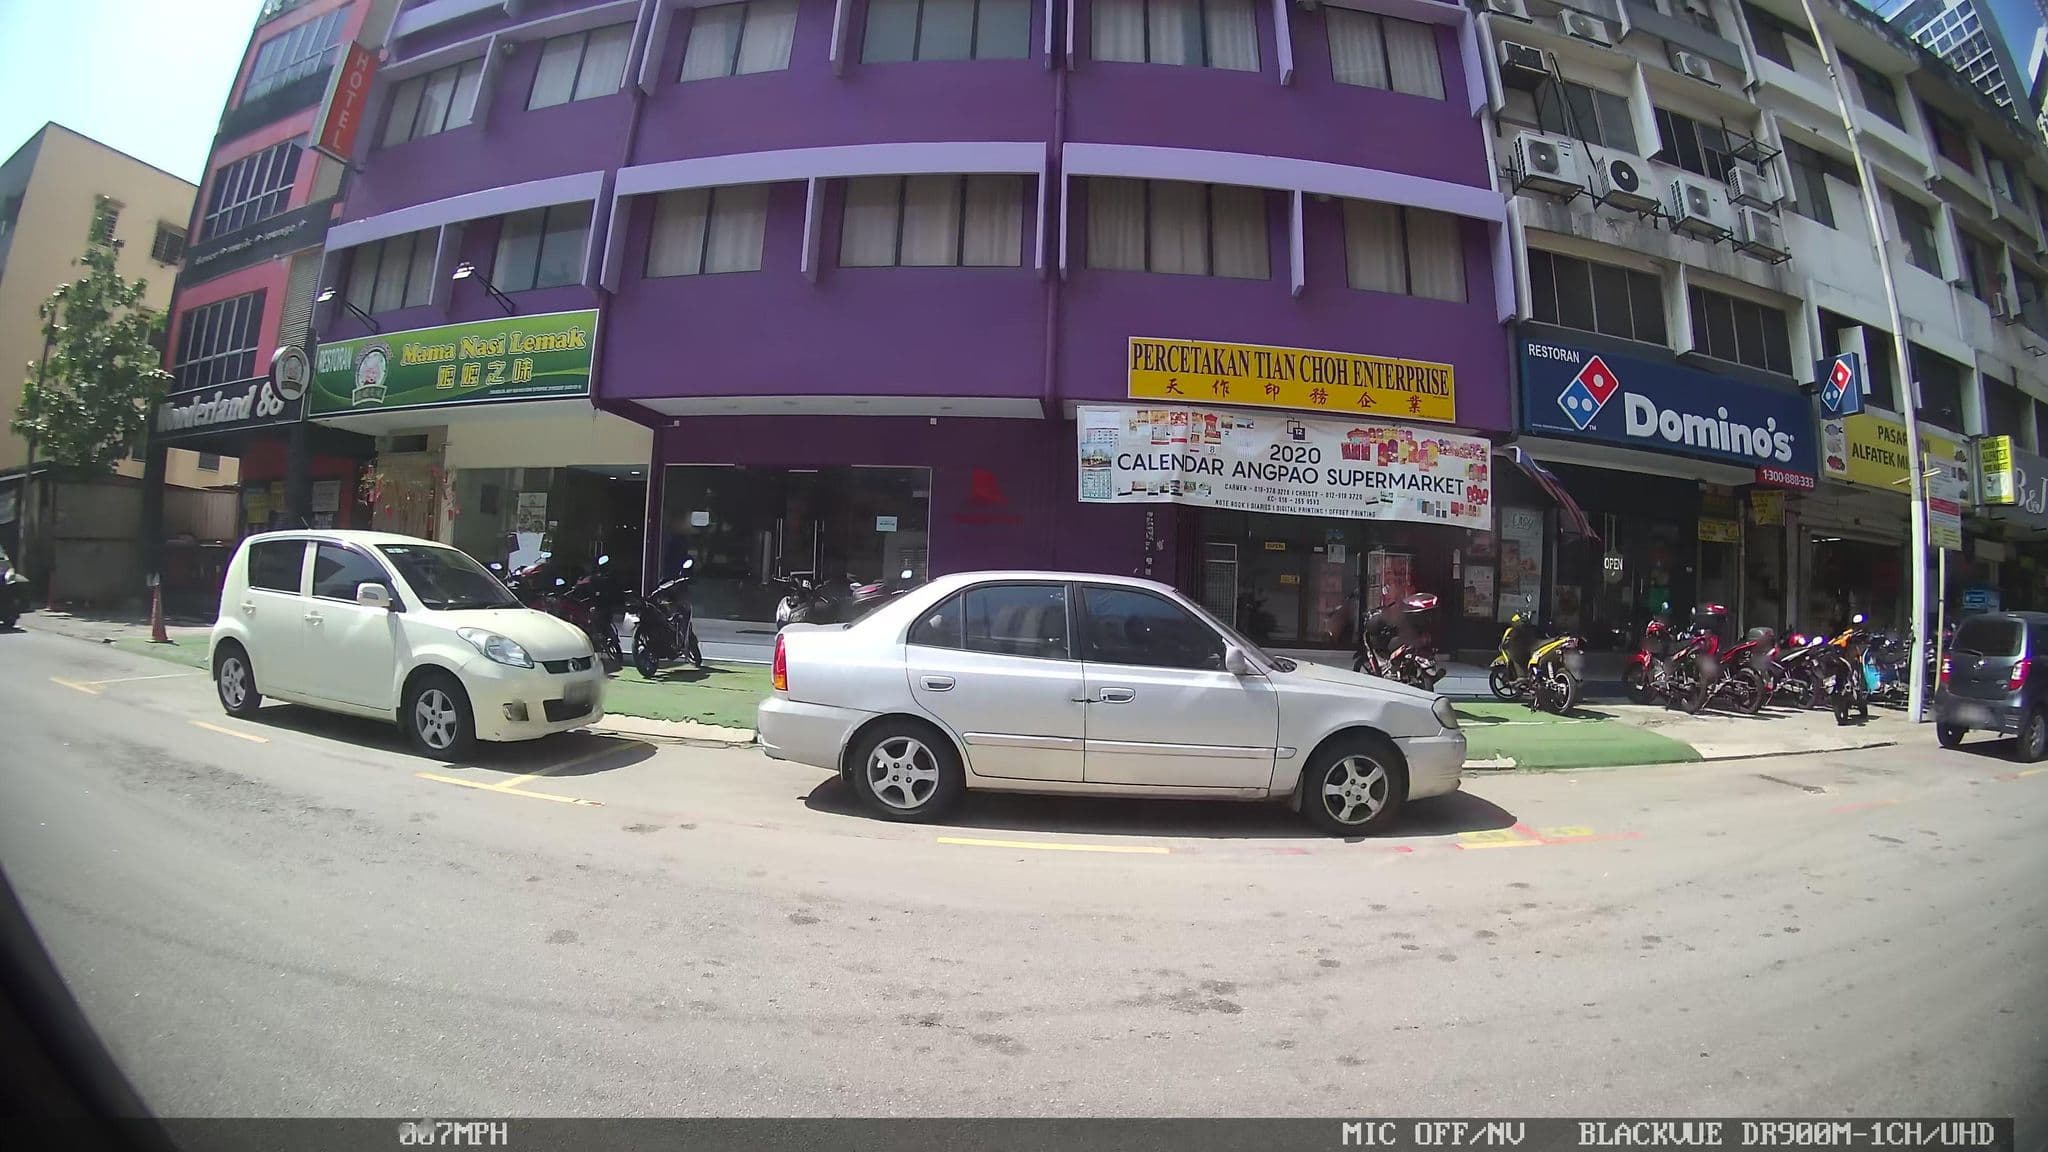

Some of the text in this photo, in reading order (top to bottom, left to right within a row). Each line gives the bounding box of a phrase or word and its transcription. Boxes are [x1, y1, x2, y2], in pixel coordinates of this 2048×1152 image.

[332, 51, 370, 153] HOTEL
[400, 342, 457, 367] Mama
[459, 333, 506, 359] Nasi
[509, 325, 586, 355] Lemak
[1528, 343, 1580, 364] RESTORAN
[1132, 343, 1450, 396] PERCETAKAN TIAN CHOH ENTERPRISE
[1624, 391, 1793, 463] Domino's
[1877, 425, 1908, 447] PASAR
[1269, 444, 1321, 464] 2020
[1851, 442, 1895, 467] ALFATEK
[1117, 453, 1464, 496] CALENDAR ANGPAO SUPERMARKET
[1224, 483, 1247, 491] CARMEN
[1276, 505, 1297, 513] DIGITAL
[1298, 506, 1324, 514] PRINTING
[1351, 510, 1376, 518] PRINTING
[1604, 557, 1623, 571] OPEN
